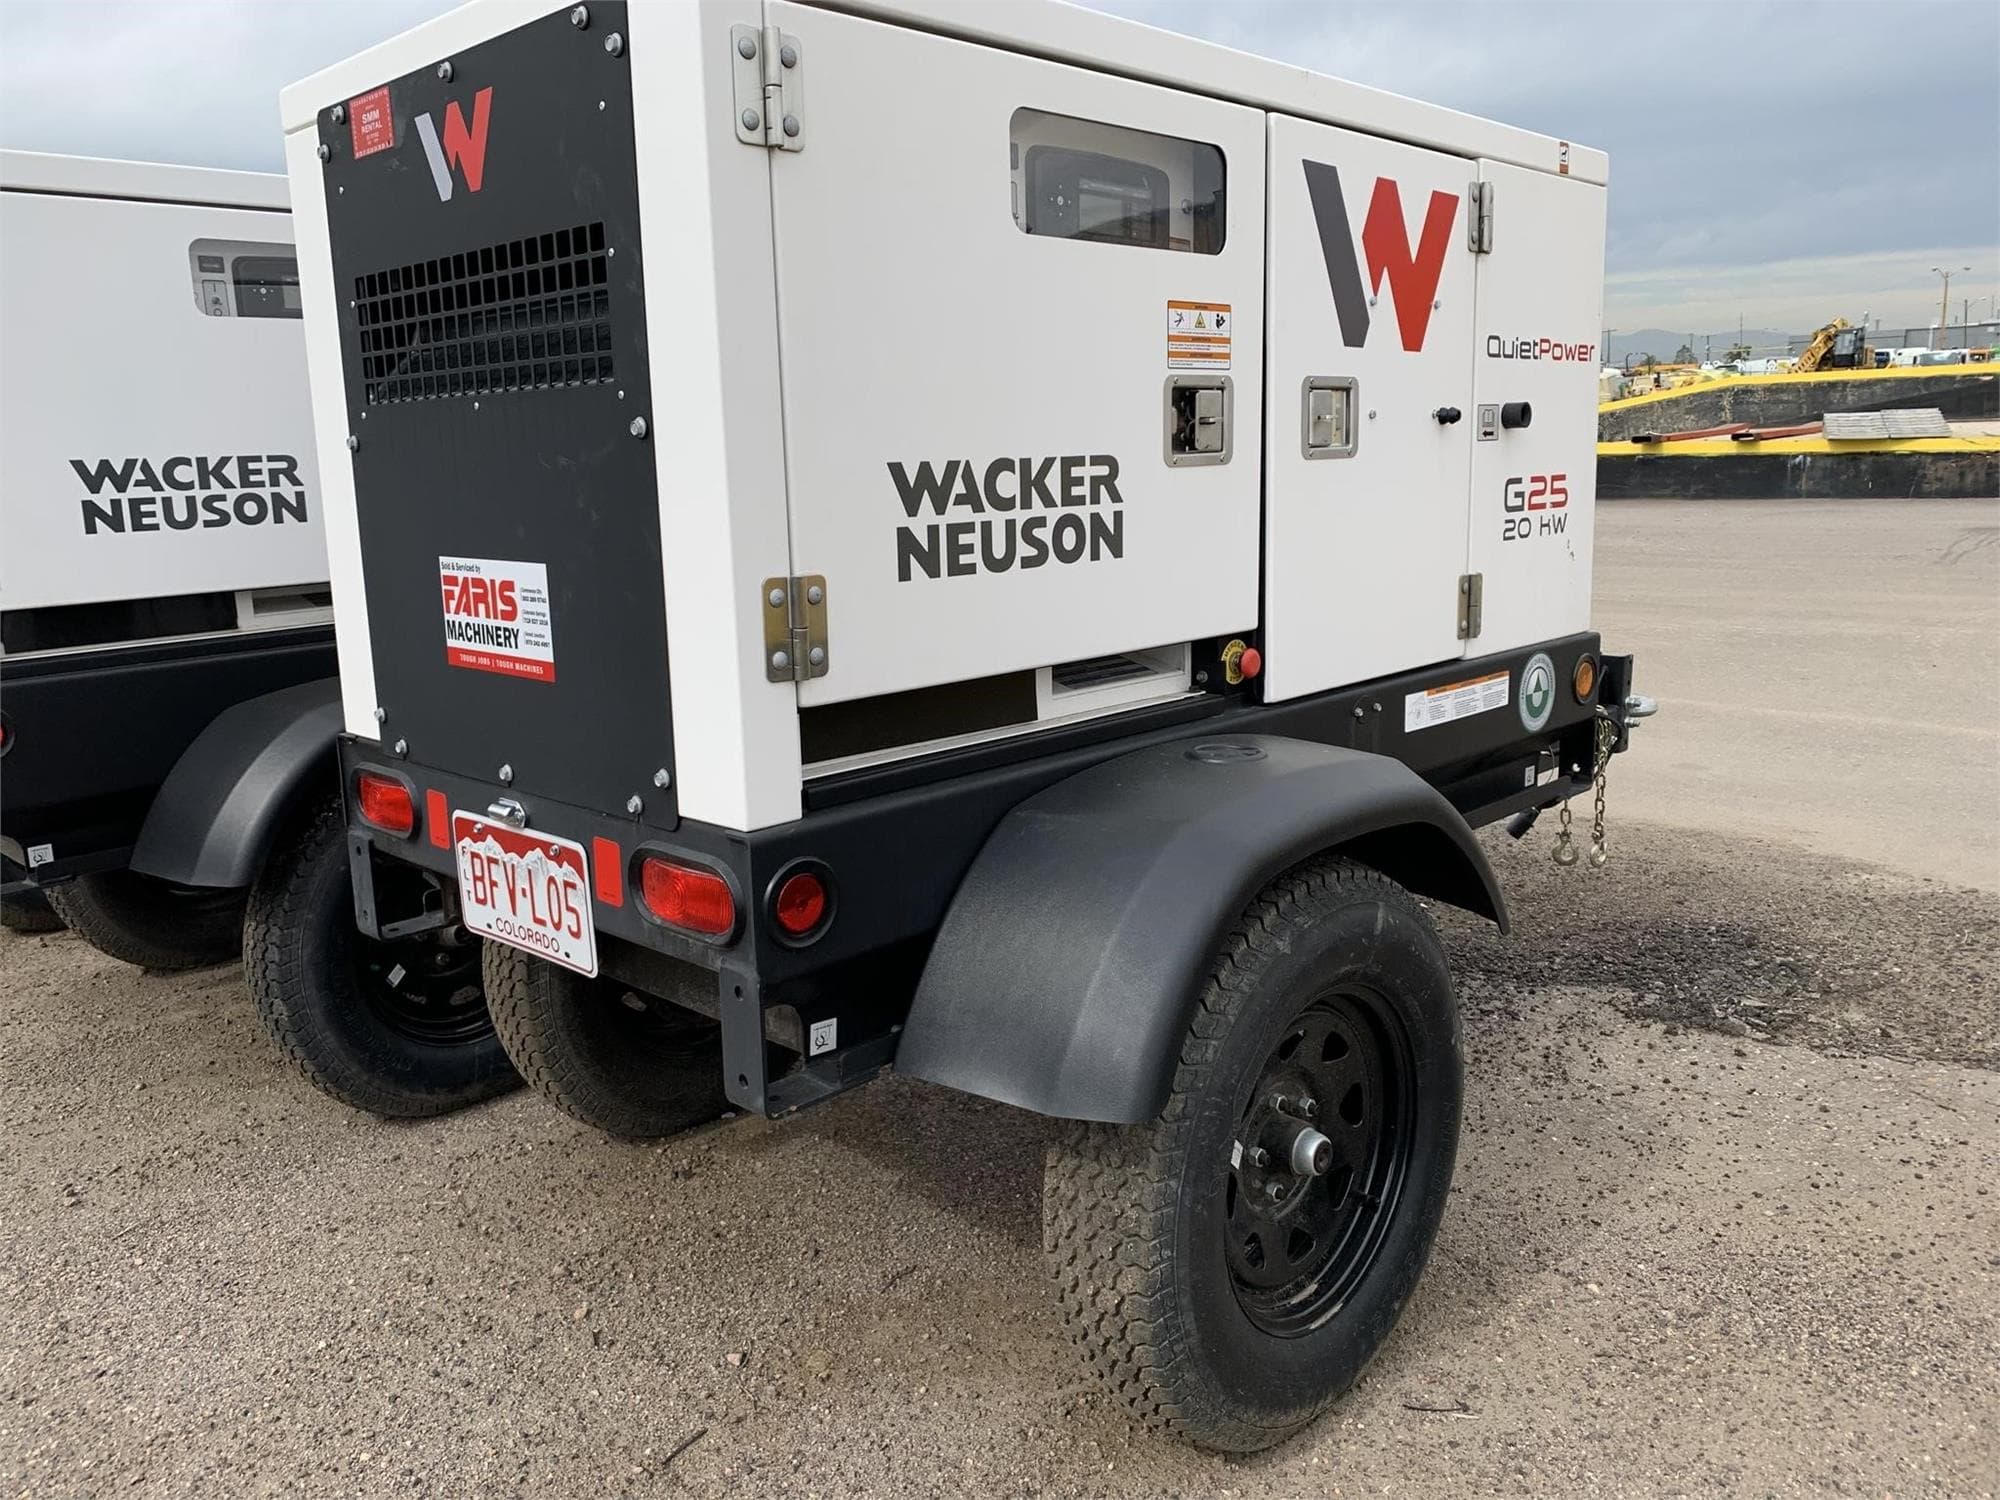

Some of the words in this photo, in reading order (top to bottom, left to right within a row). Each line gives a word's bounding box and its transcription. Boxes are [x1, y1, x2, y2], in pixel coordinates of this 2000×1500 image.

[361, 120, 382, 134] RENTAL
[362, 109, 380, 124] SMM
[1487, 335, 1595, 362] QuietPower
[69, 454, 304, 494] WACKER
[886, 455, 1124, 518] WACKER
[1504, 474, 1569, 513] G25
[81, 491, 308, 535] NEUSON
[1503, 517, 1532, 541] 20
[896, 510, 1125, 583] NEUSON
[441, 561, 450, 570] Sold
[456, 562, 475, 572] Serviced
[475, 564, 480, 574] by
[442, 574, 518, 622] FARIS
[446, 619, 520, 650] MACHINERY
[460, 654, 477, 664] TOUGH
[478, 656, 491, 666] JOBS
[496, 659, 514, 670] TOUGH
[515, 662, 544, 675] MACHINES
[496, 917, 561, 953] COLORADO
